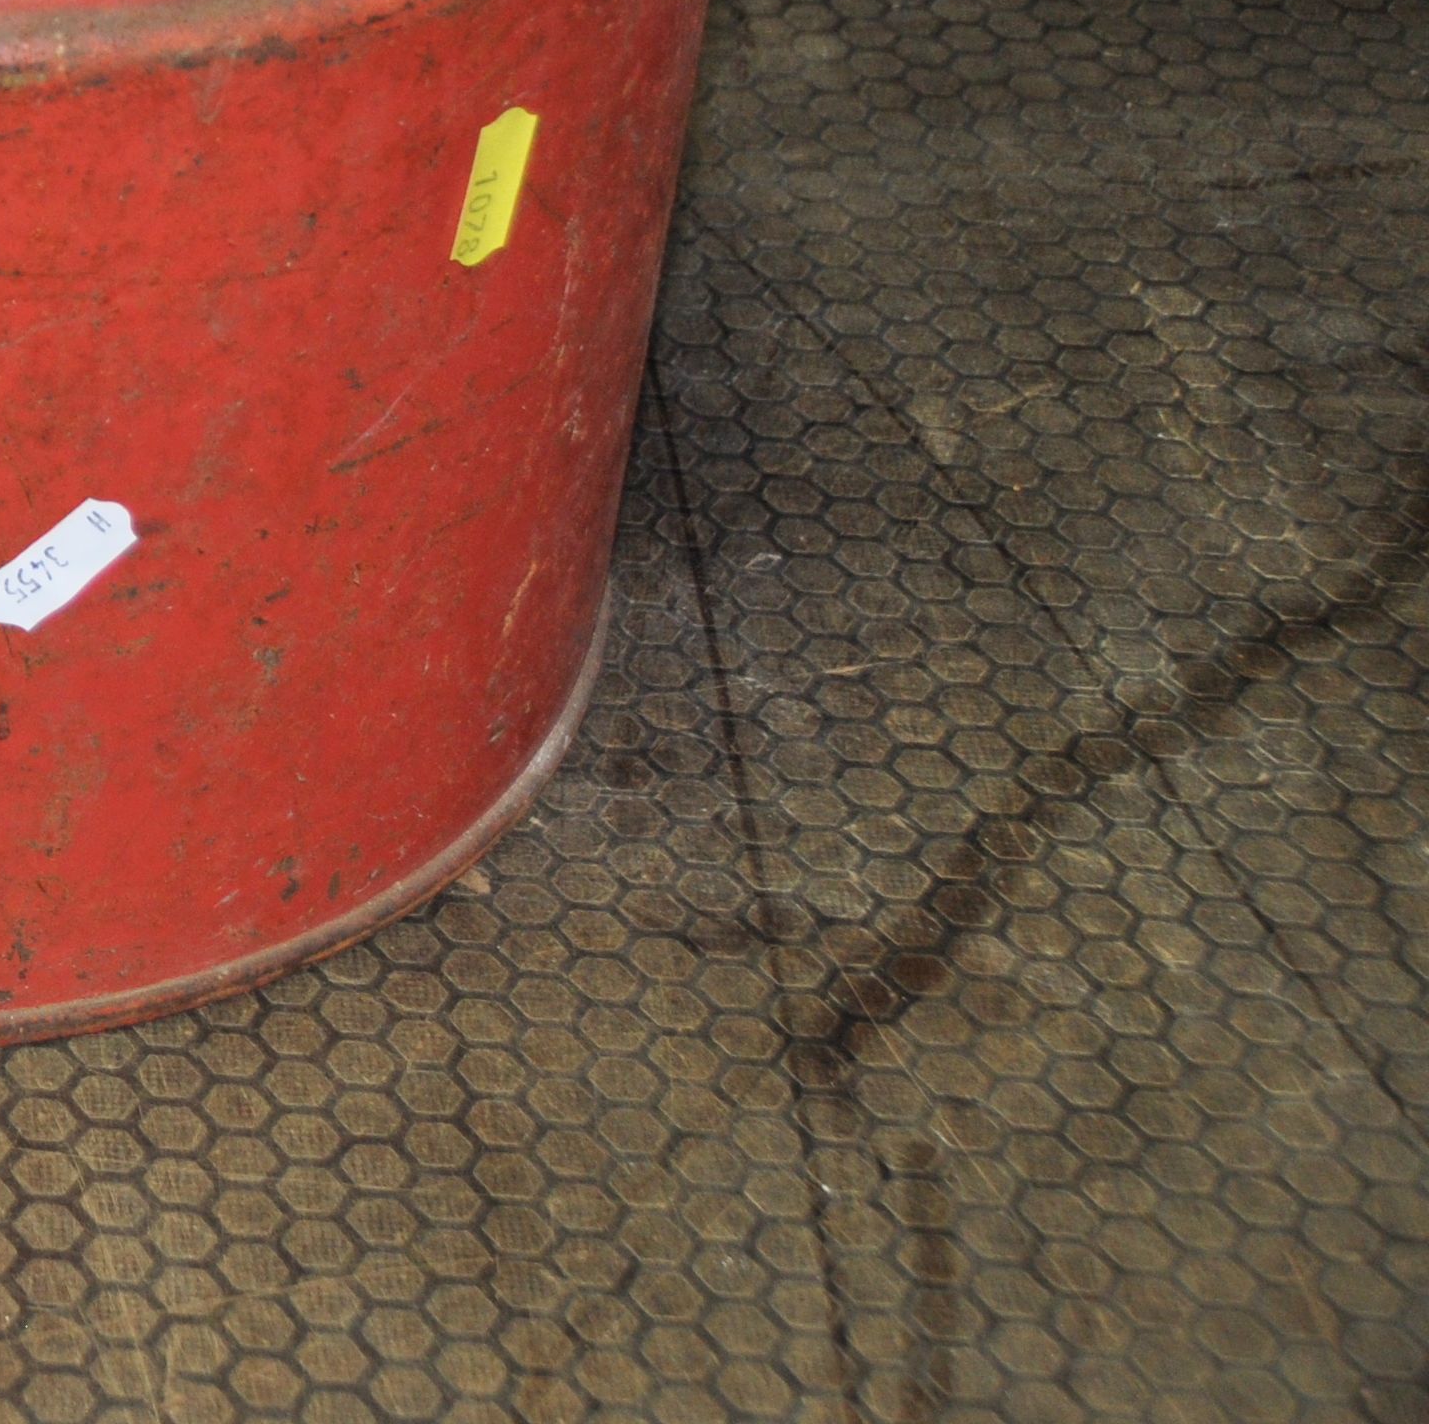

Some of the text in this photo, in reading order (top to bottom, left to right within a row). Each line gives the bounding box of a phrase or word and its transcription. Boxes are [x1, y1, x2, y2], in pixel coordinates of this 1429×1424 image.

[456, 170, 498, 257] 1078
[4, 511, 112, 603] H 3455
